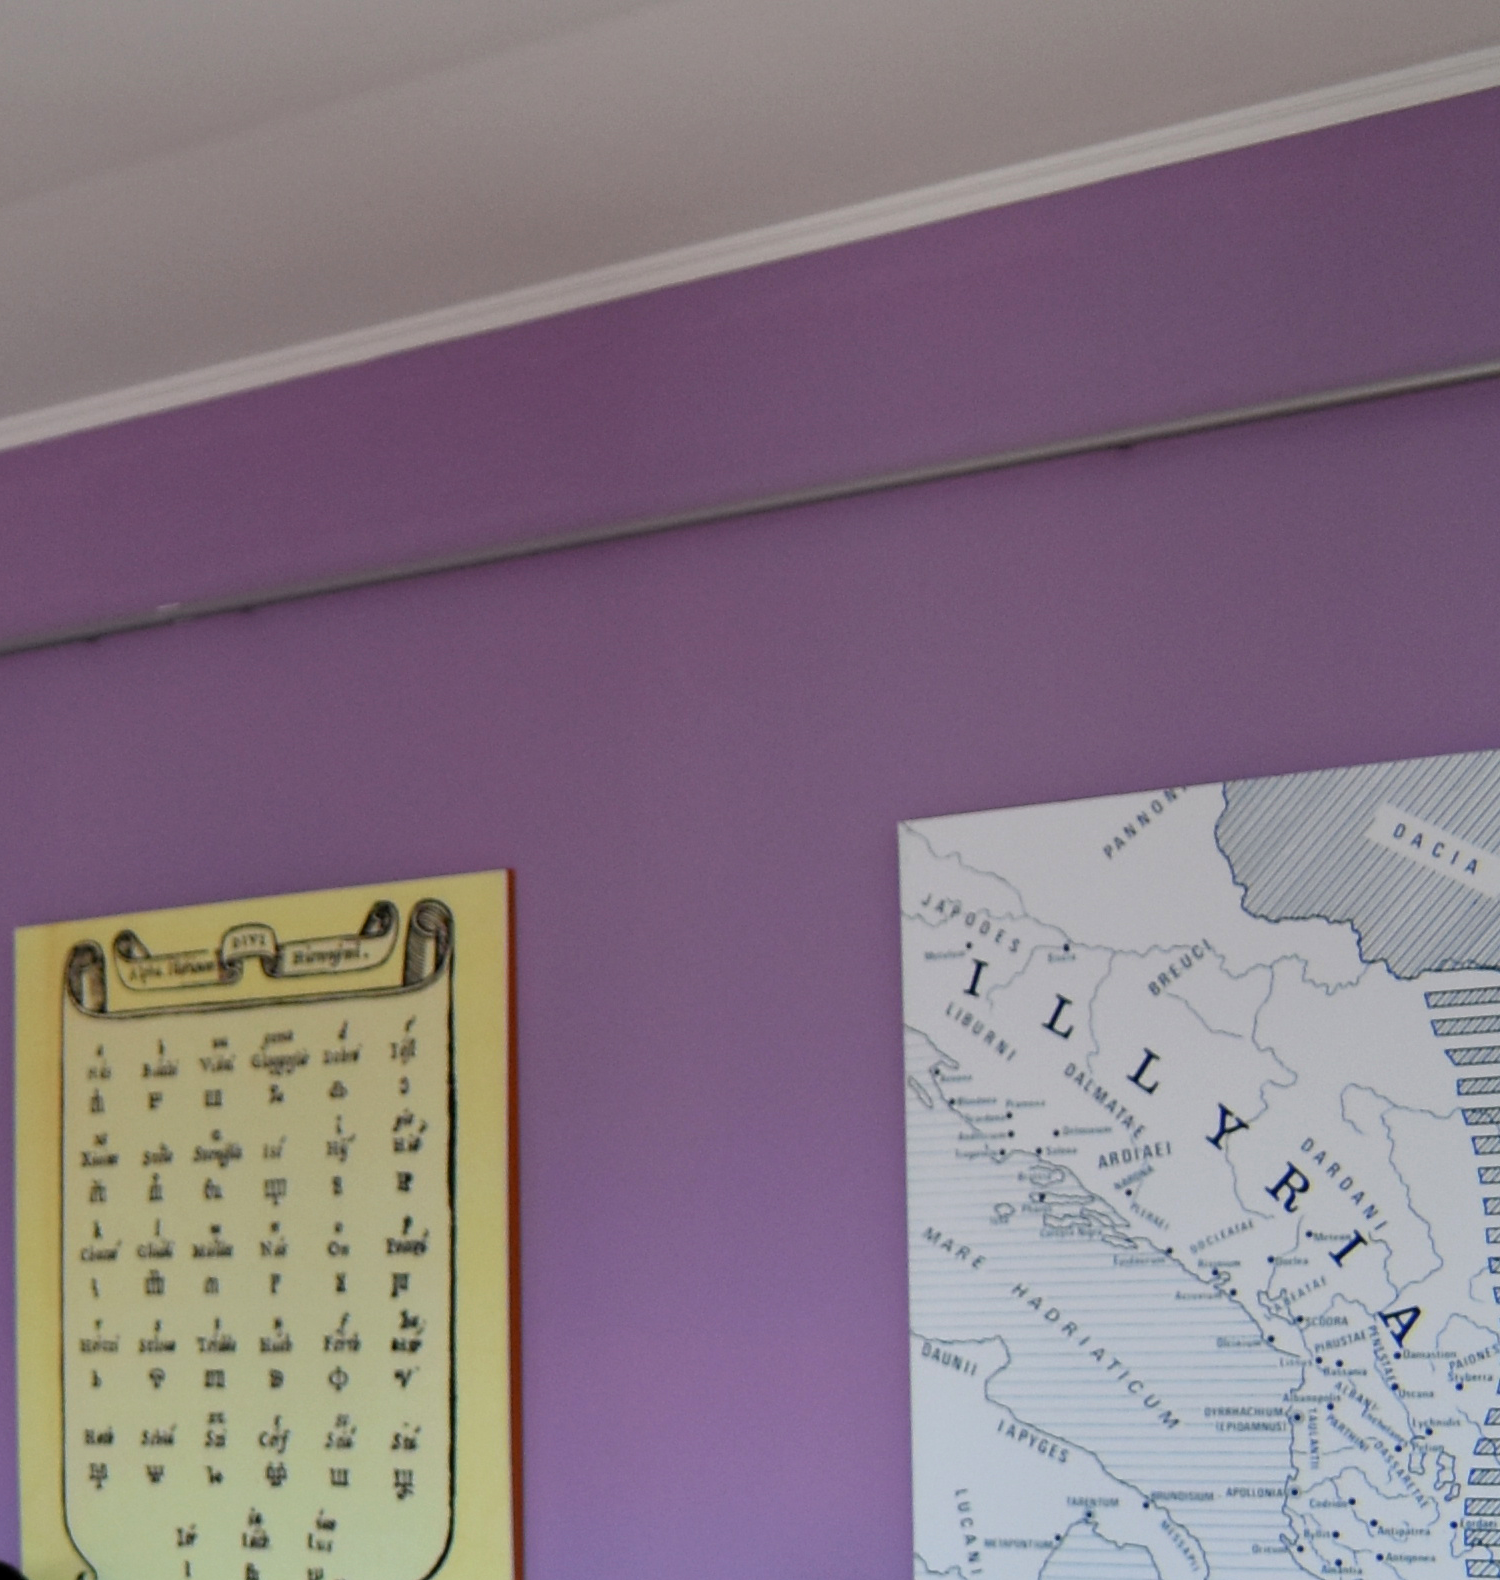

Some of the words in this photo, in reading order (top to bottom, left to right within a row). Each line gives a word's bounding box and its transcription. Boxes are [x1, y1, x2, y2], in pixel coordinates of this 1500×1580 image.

[1103, 785, 1188, 859] PANNON
[1393, 822, 1479, 876] DACIA
[921, 893, 1020, 952] JAPODES
[1148, 938, 1214, 996] BREUCI
[946, 1001, 1017, 1061] LIBURNI
[1064, 1062, 1146, 1138] DALMATAE
[1098, 1140, 1173, 1170] ARDIAEI
[1300, 1136, 1389, 1232] DARDANI
[922, 1226, 987, 1270] MARE
[1011, 1282, 1181, 1430] HADRIATICUM
[921, 1341, 978, 1378] DAUNII
[997, 1418, 1070, 1464] IAPYGES
[1225, 1486, 1284, 1499] APOLLONIA
[953, 1487, 984, 1576] LUCANI
